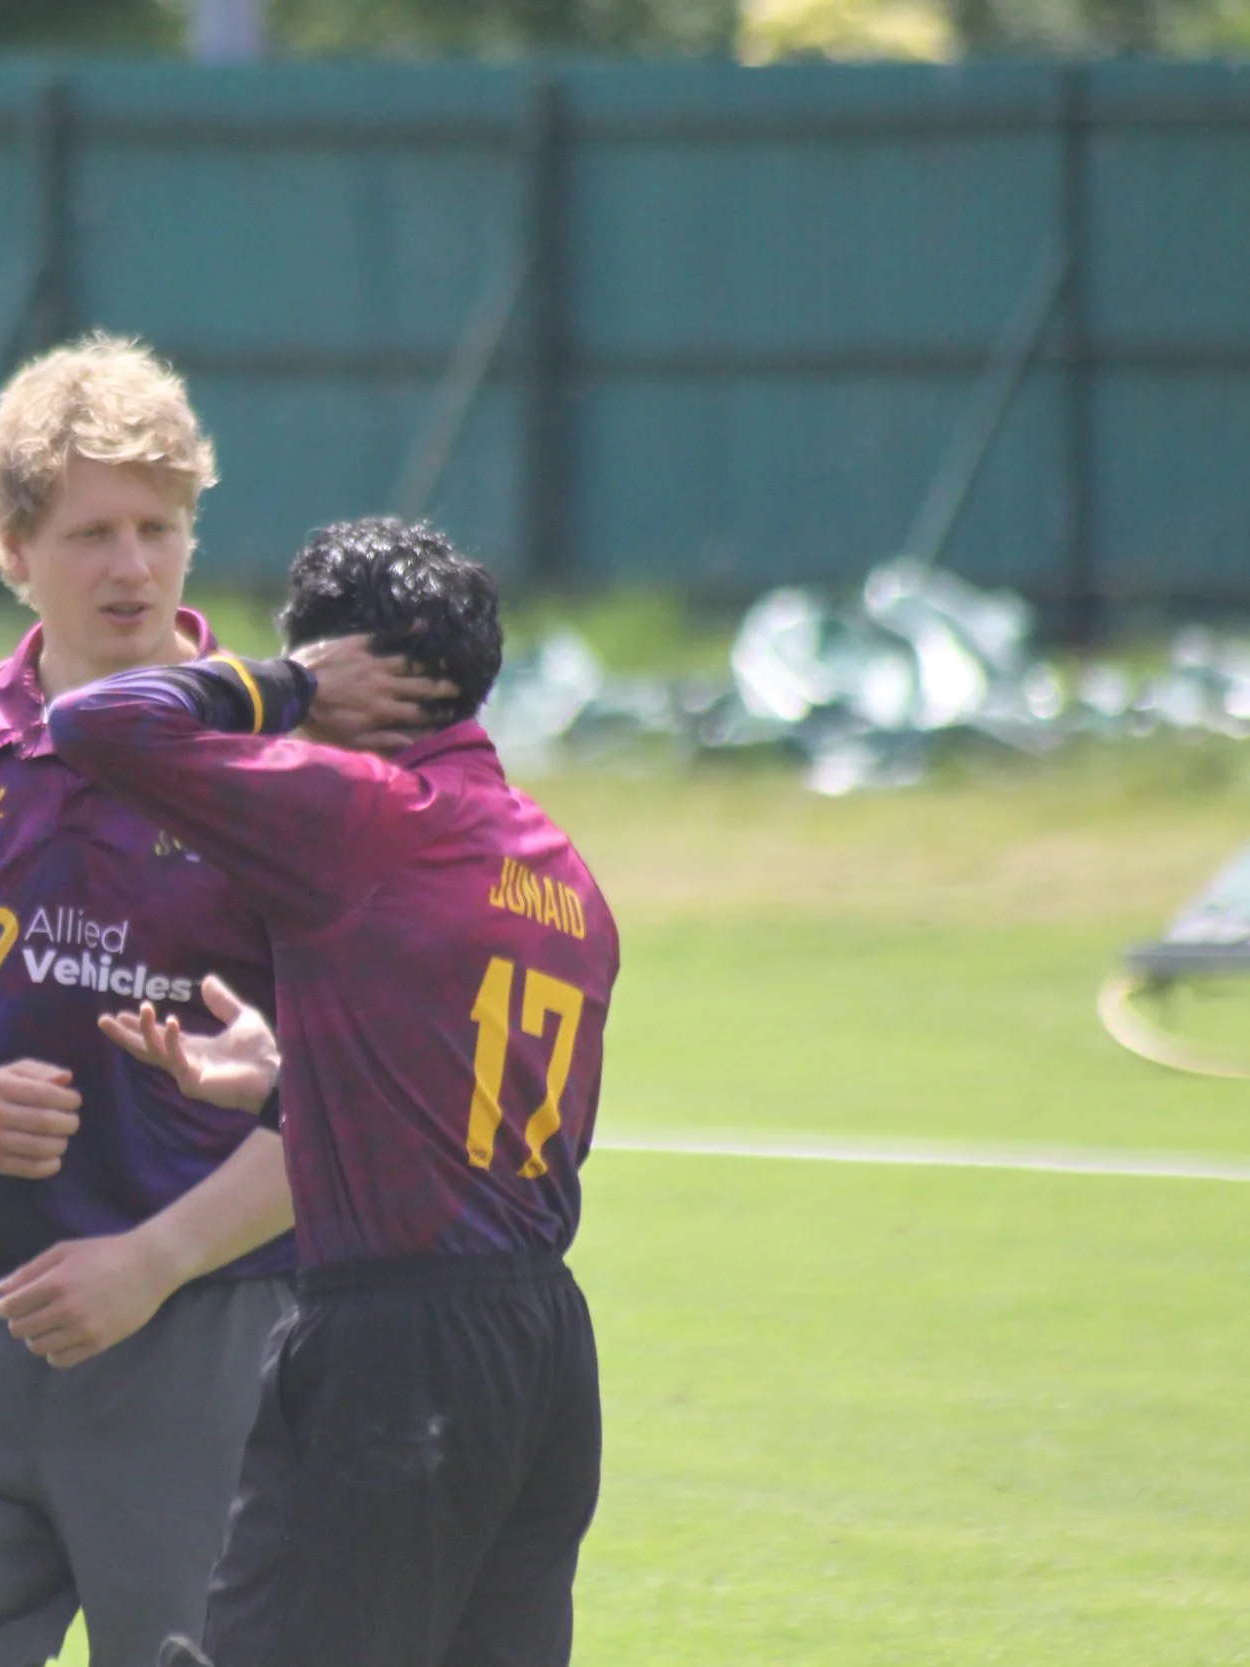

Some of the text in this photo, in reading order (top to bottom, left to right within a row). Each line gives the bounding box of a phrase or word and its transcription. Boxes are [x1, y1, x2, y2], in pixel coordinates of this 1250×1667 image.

[24, 906, 128, 954] Allied
[489, 856, 586, 940] JUNAID
[21, 949, 192, 1002] Vehicles
[465, 956, 584, 1180] 17
